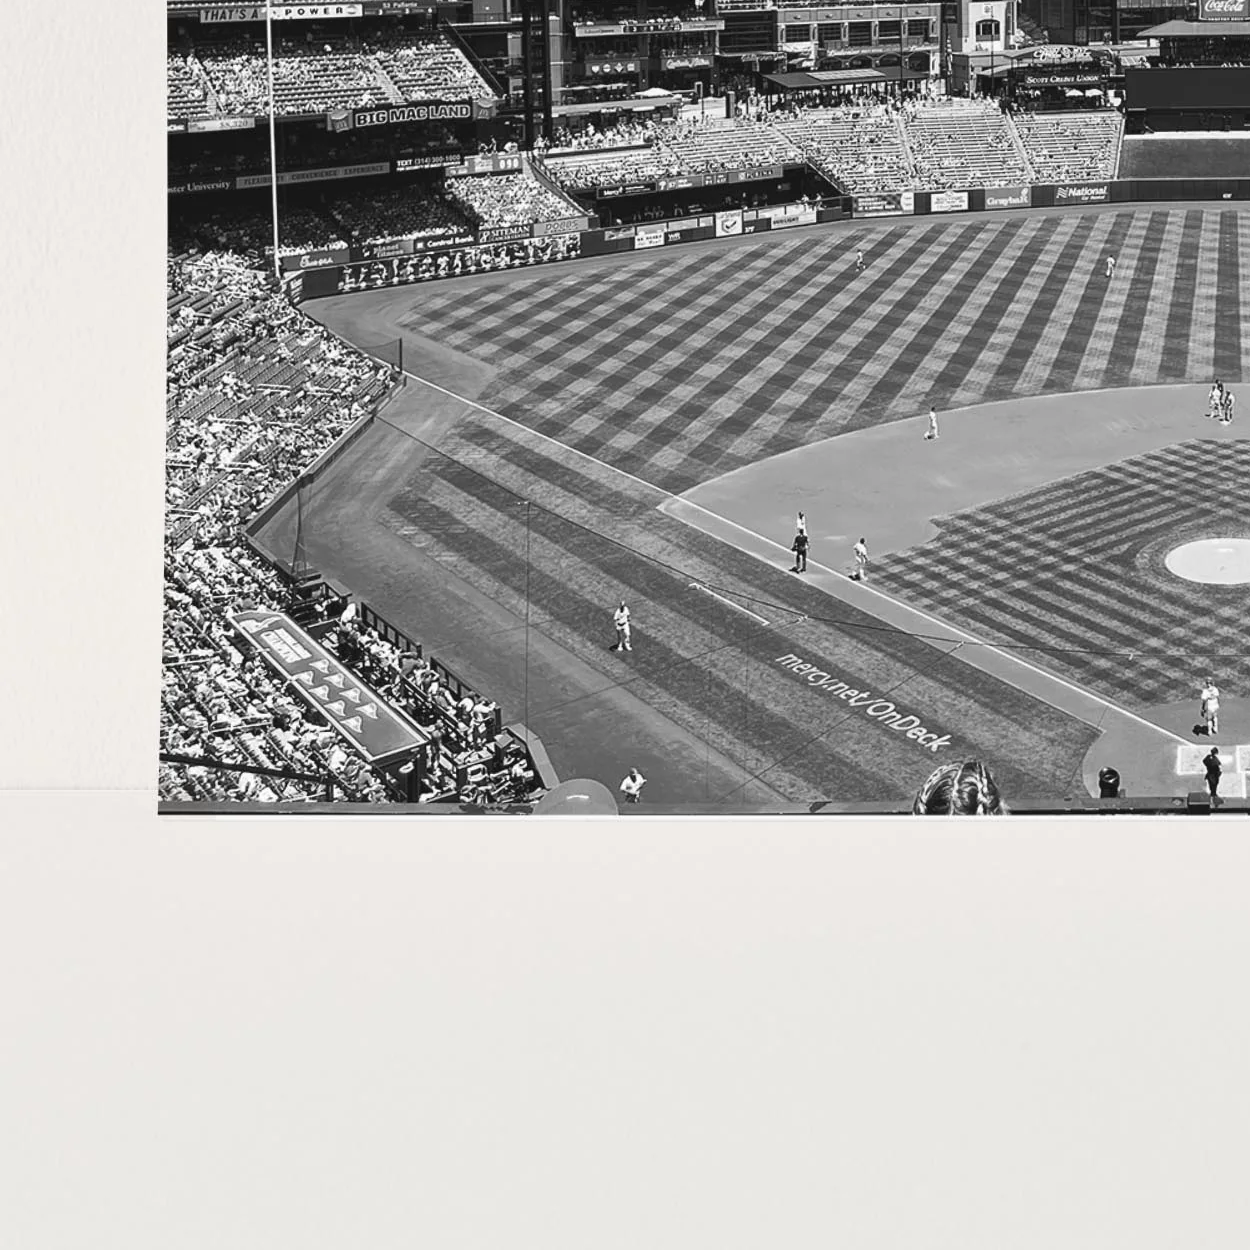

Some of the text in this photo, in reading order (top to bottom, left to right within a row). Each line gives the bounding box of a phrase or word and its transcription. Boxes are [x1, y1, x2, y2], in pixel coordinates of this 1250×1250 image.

[203, 9, 247, 21] THAT'S
[285, 7, 344, 17] POWER
[357, 104, 471, 126] BIG MAC LAND
[187, 180, 231, 192] University
[1068, 186, 1108, 197] National
[491, 225, 530, 237] SITEMAN
[427, 235, 475, 248] Central Bank
[775, 651, 953, 752] mercy.net/OnDeck
